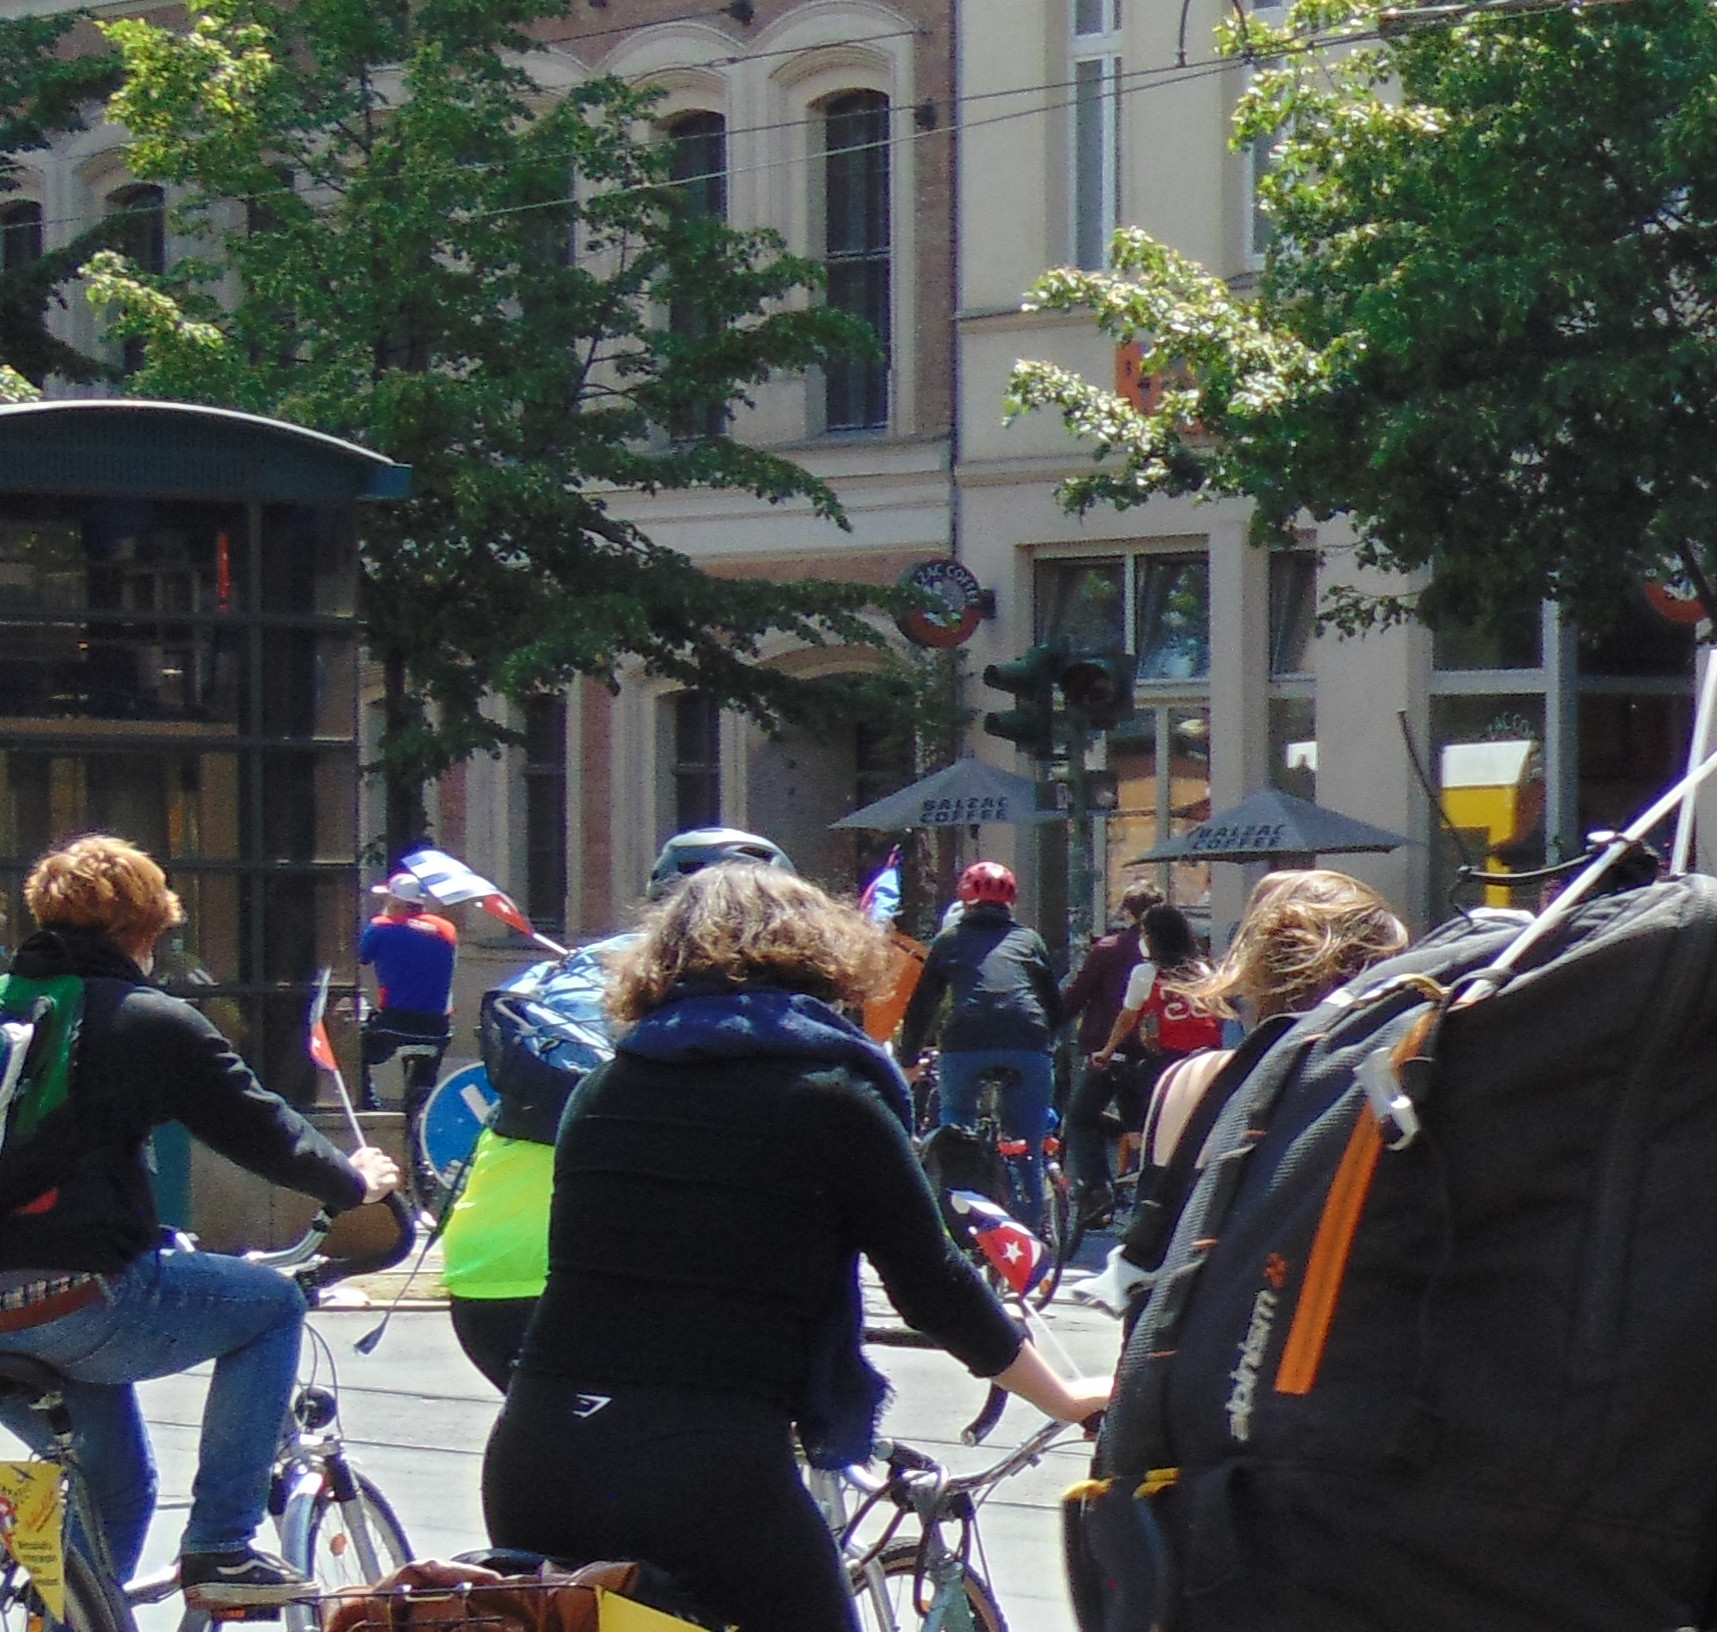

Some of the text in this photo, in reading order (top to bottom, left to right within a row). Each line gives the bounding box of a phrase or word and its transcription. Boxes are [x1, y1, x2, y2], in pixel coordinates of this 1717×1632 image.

[922, 796, 1009, 811] BALZAC
[920, 808, 1007, 824] COFFEE
[1192, 836, 1281, 850] COFFEE
